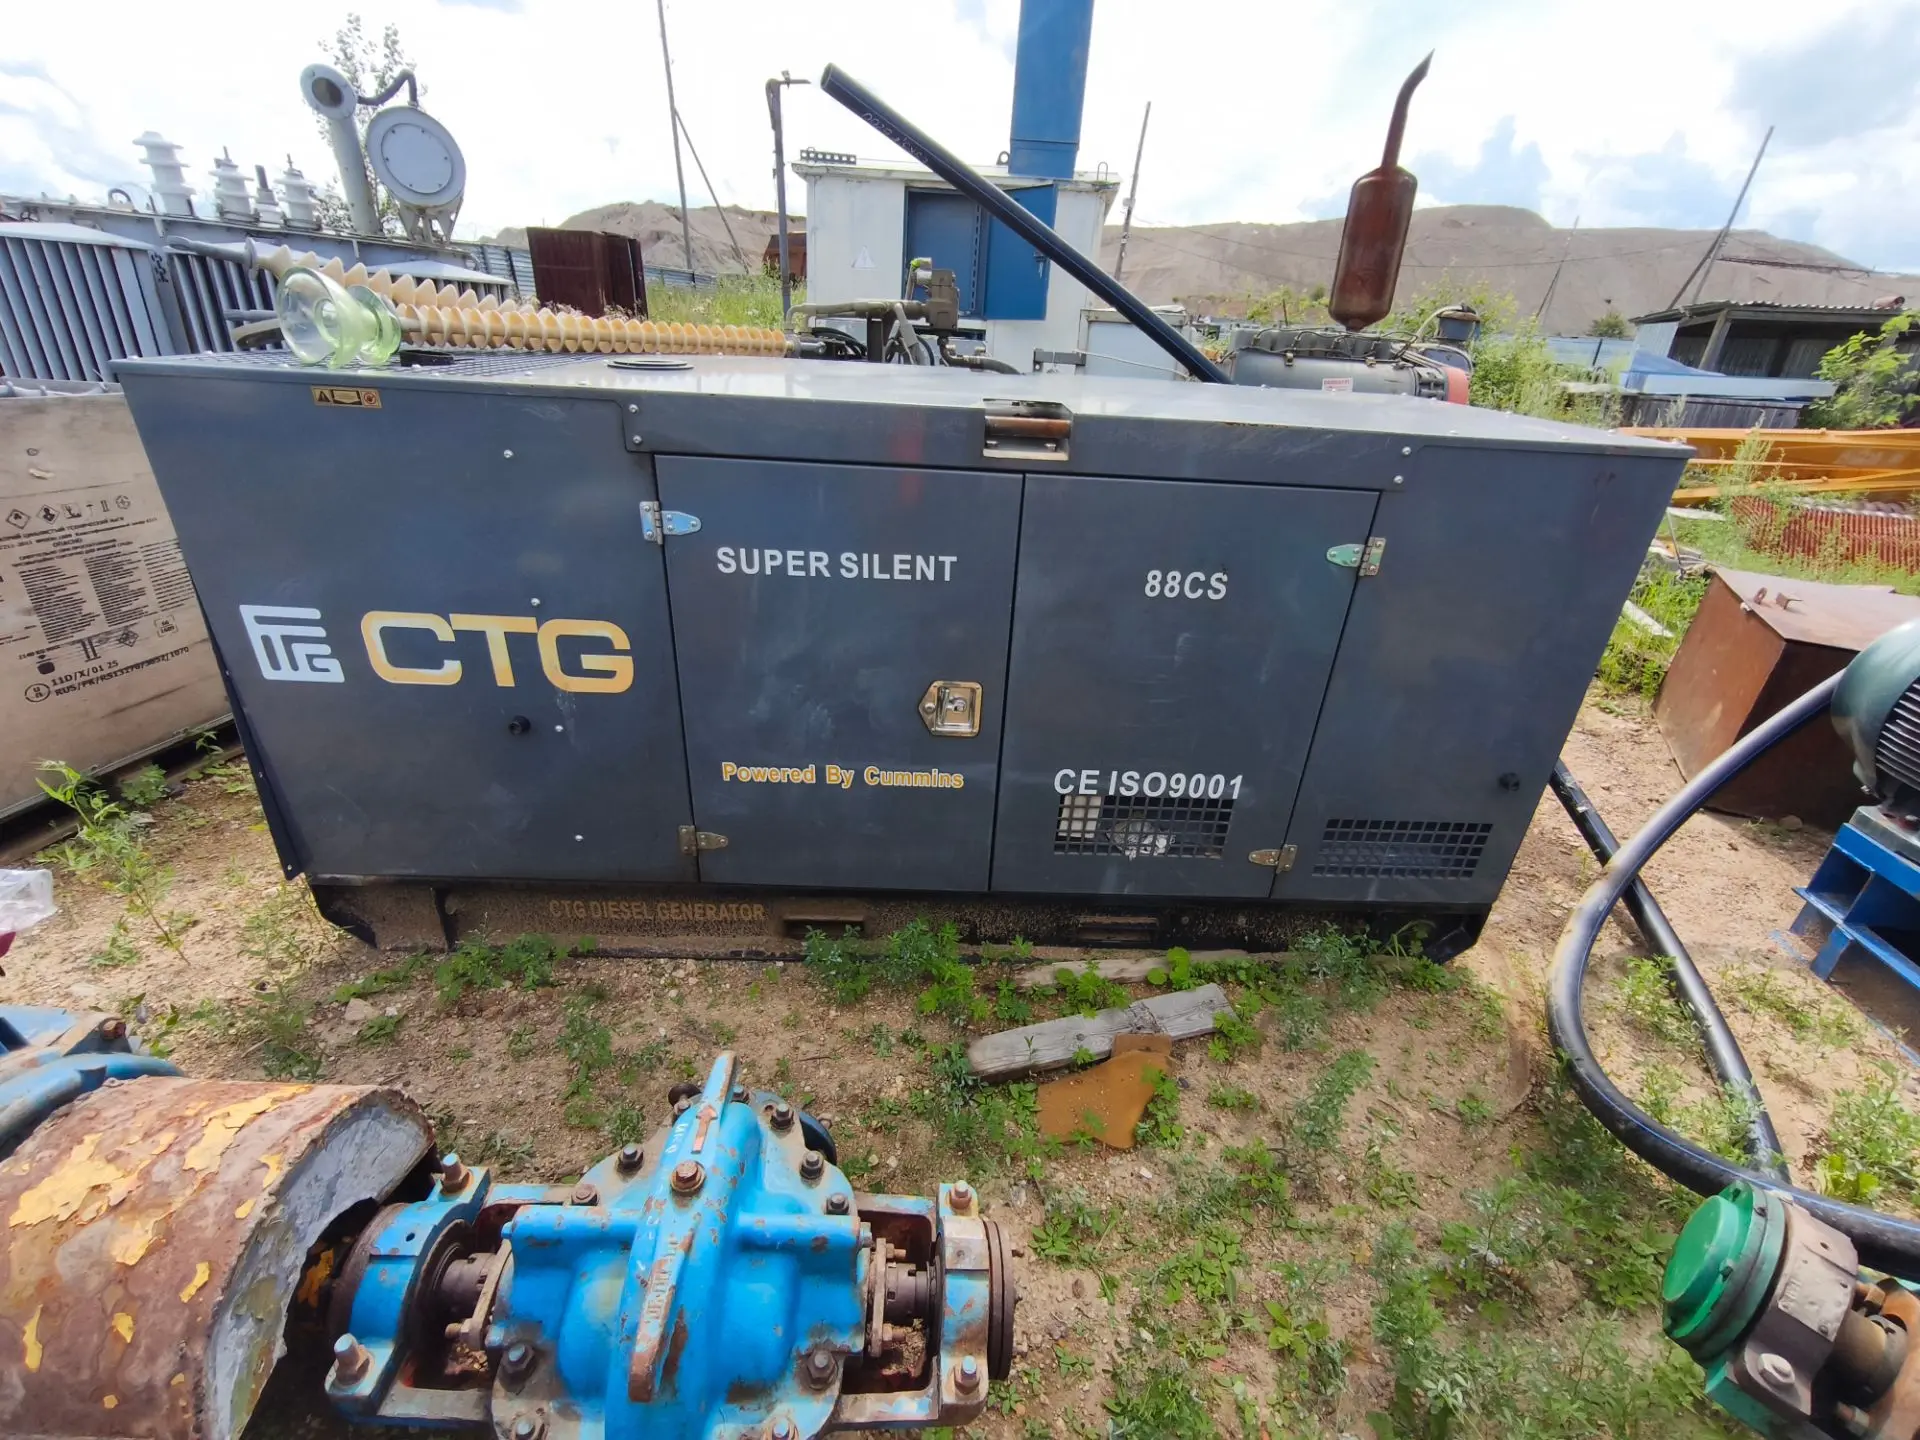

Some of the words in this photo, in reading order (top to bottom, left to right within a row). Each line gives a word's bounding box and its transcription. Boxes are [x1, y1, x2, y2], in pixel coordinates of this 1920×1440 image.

[717, 546, 831, 578] SUPER
[839, 552, 958, 582] SILENT
[1144, 569, 1228, 600] 88CS
[360, 610, 634, 694] CTG
[721, 761, 817, 785] Powered
[825, 764, 855, 789] By
[863, 766, 966, 790] Cummins
[1053, 768, 1101, 796] CE
[1108, 770, 1243, 800] ISO9001
[549, 899, 587, 920] CTG
[590, 900, 653, 920] DIESEL
[655, 902, 766, 921] GENERATOR
